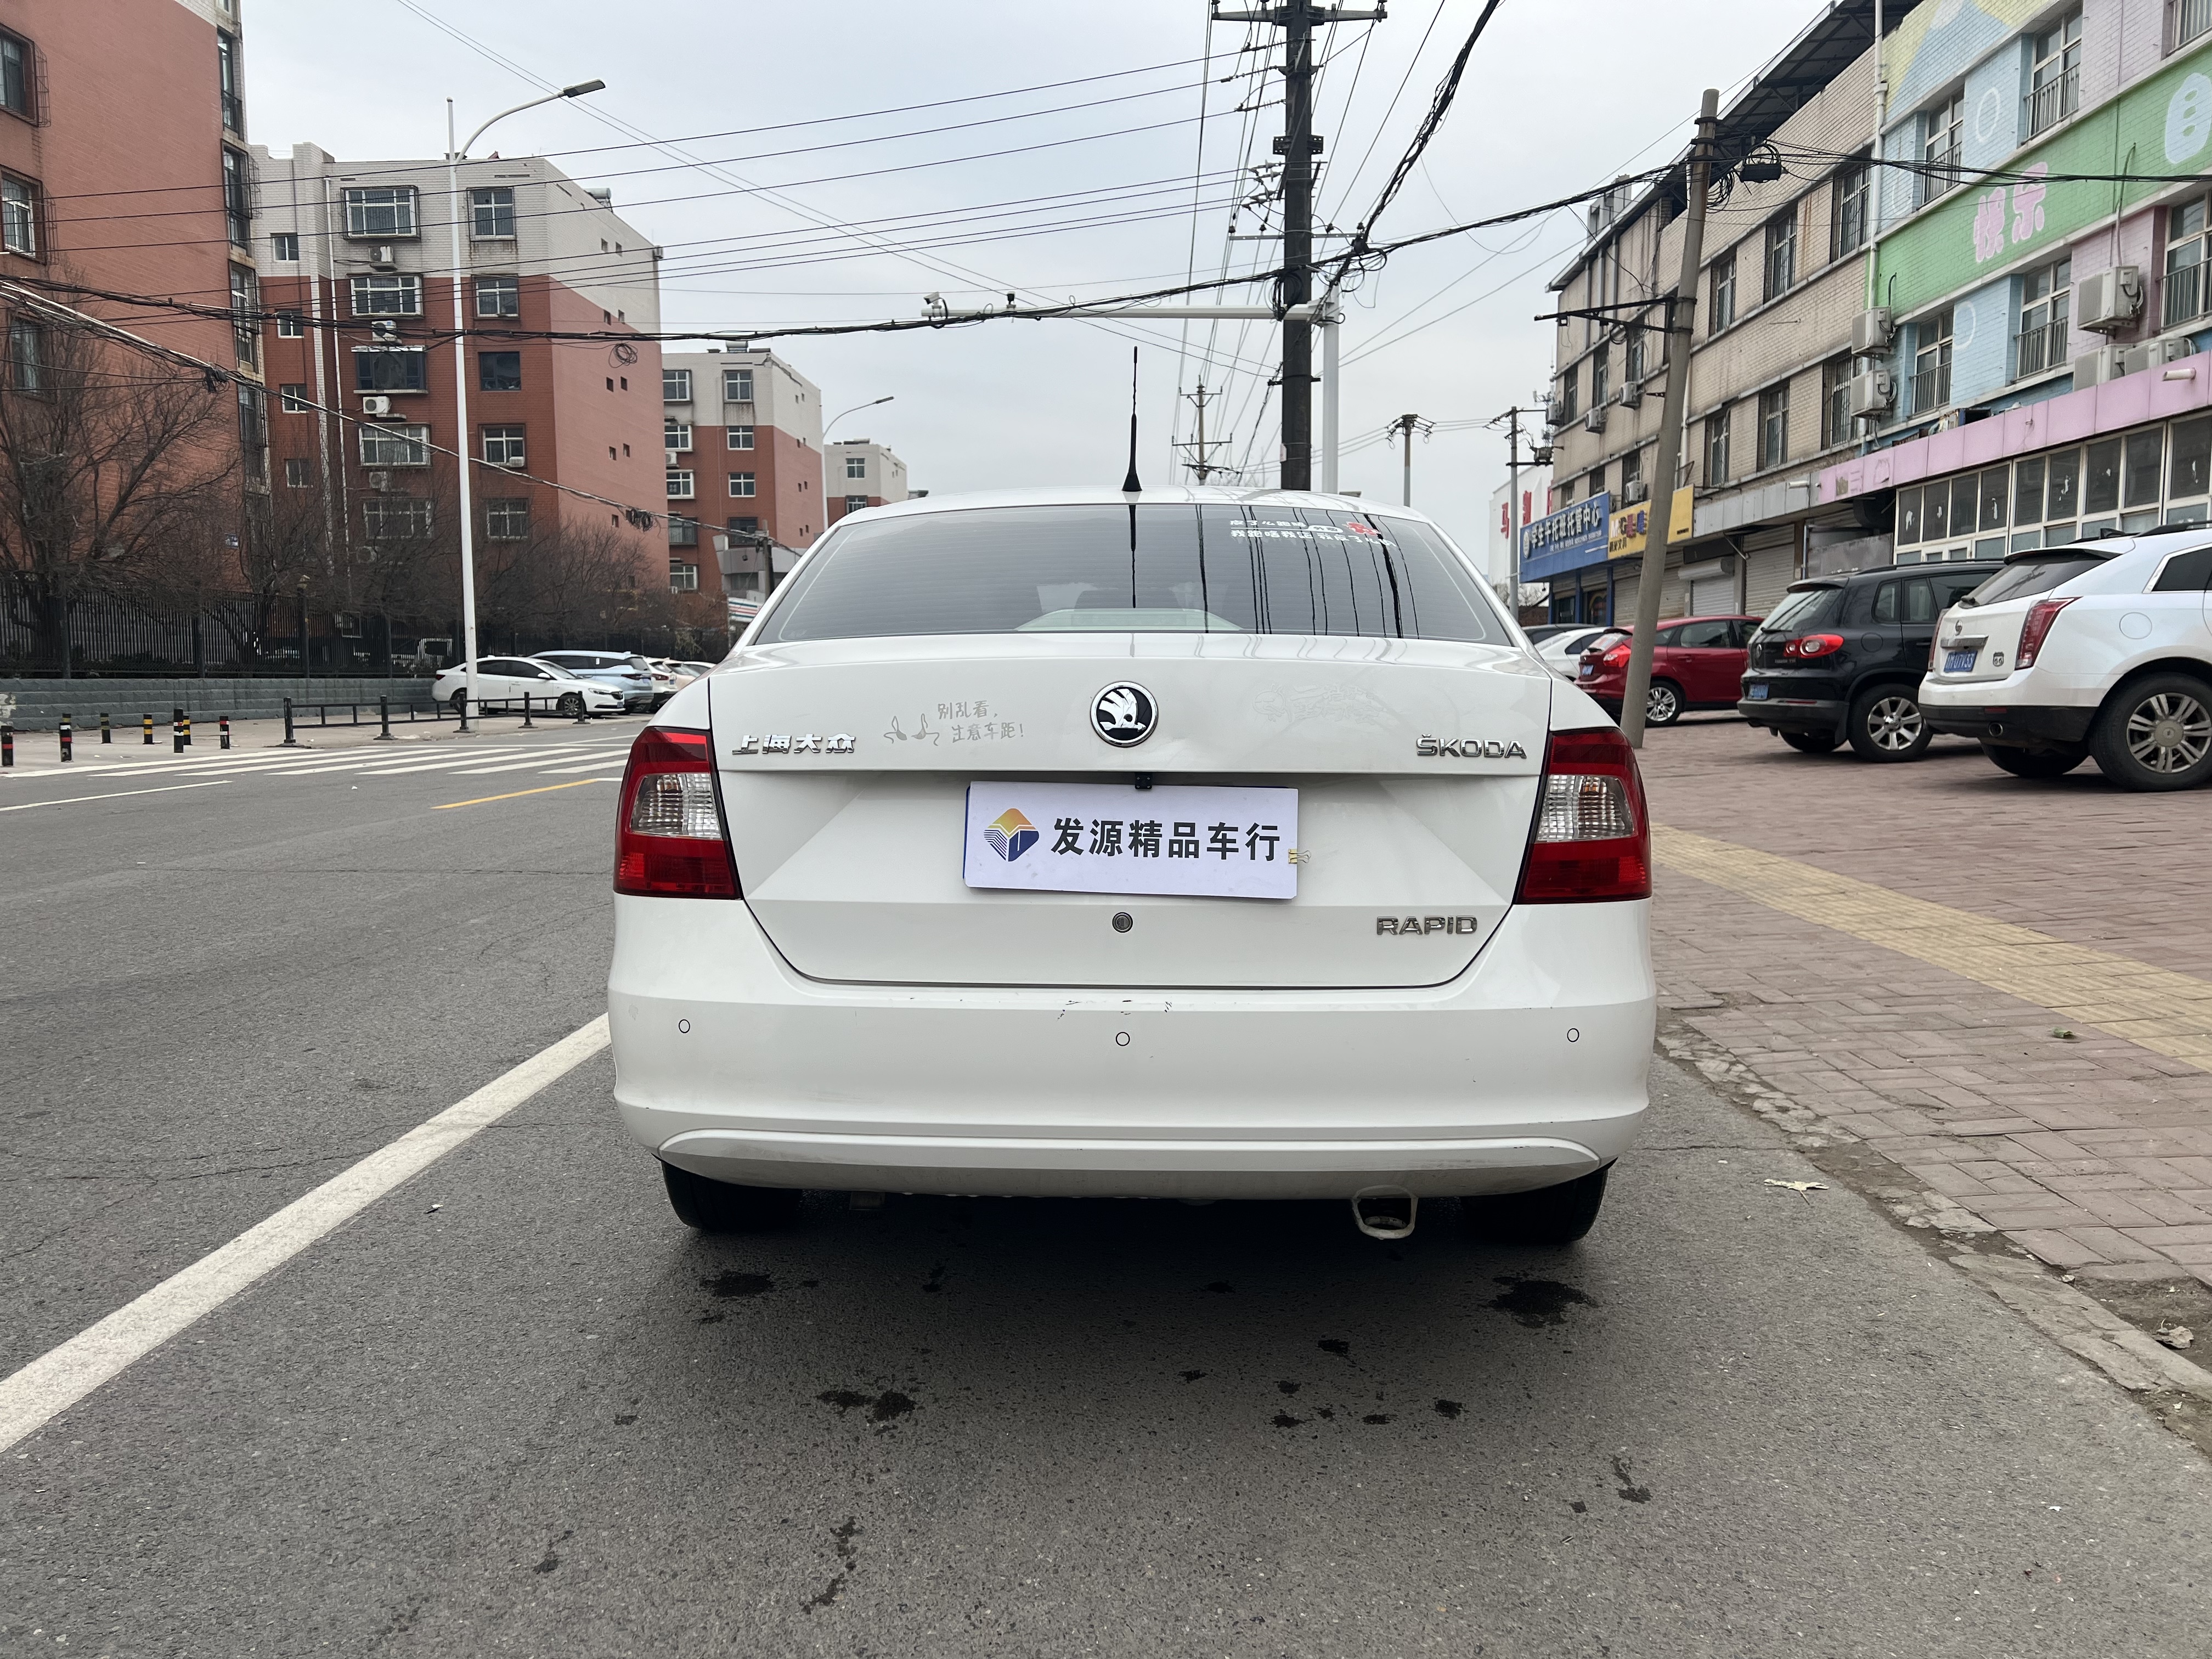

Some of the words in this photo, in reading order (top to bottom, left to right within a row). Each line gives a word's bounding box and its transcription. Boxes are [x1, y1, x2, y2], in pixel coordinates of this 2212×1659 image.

[732, 733, 856, 755] 上海大众
[1416, 733, 1528, 760] ŠKODA
[1051, 817, 1280, 863] 发源精品车行
[1376, 916, 1478, 936] RAPID
